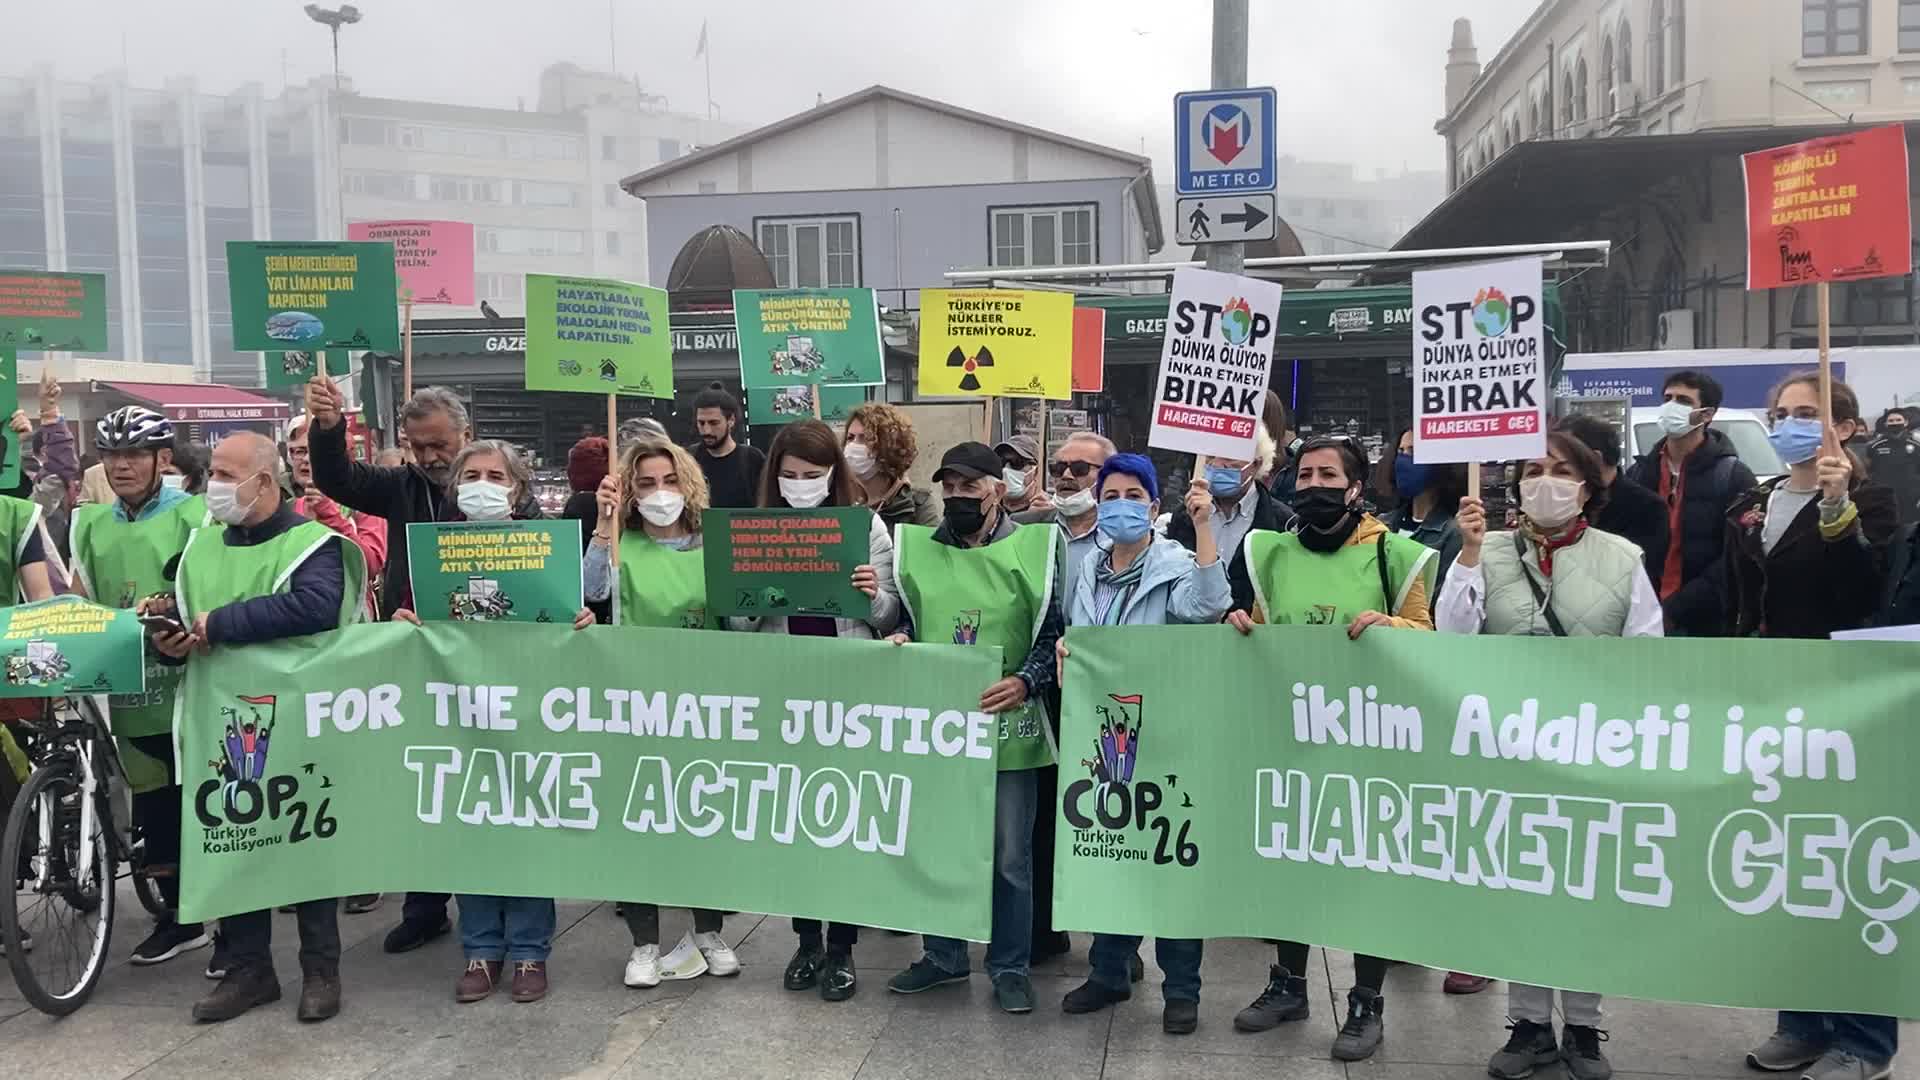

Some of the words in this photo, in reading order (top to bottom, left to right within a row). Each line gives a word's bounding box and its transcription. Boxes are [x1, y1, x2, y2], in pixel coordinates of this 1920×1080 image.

[1192, 172, 1261, 189] METRO
[1771, 202, 1851, 225] KAPATILSIN
[264, 254, 288, 276] ŞEHİR
[266, 276, 289, 291] YAT
[289, 274, 354, 291] LİMANLARI
[268, 293, 327, 308] KAPATILSIN
[557, 289, 630, 304] HAYATLARA
[631, 296, 644, 307] VE
[760, 298, 814, 310] MİNİMUM
[815, 299, 840, 308] ATIK
[948, 300, 1022, 311] TÜRKİYE'DE
[557, 302, 615, 316] EKOLOJİK
[1420, 288, 1536, 342] STOP
[557, 316, 618, 329] MALOLAN
[762, 323, 790, 333] ATIK
[793, 320, 848, 331] YÖNETİMİ
[948, 313, 1004, 323] NÜKLEER
[1174, 297, 1271, 347] STOP
[557, 330, 634, 344] KAPATILSIN.
[948, 326, 1036, 337] İSTEMİYORUZ.
[1171, 335, 1215, 362] DÜNYA
[1219, 342, 1266, 371] ÖLÜYOR
[1423, 342, 1473, 366] DÜNYA
[1478, 336, 1537, 361] ÖLÜYOR
[1168, 357, 1212, 378] İNKAR
[1216, 368, 1264, 387] ETMEYİ
[1422, 367, 1473, 383] İNKAR
[1479, 359, 1537, 379] ETMEYİ
[1163, 376, 1260, 416] BIRAK
[1422, 378, 1537, 414] BIRAK
[1163, 409, 1225, 430] HAREKETE
[1230, 419, 1252, 437] GEÇ
[1426, 418, 1499, 434] HAREKETE
[1507, 415, 1535, 432] GEÇ
[730, 519, 776, 529] MADEN
[778, 518, 841, 533] ÇIKARMA
[438, 532, 504, 545] MİNİMUM
[506, 532, 538, 543] ATIK
[541, 532, 552, 543] &
[731, 534, 758, 544] HEM
[760, 532, 797, 544] DOĞA
[438, 543, 552, 559] SÜRDÜRÜLEBİLİR
[732, 547, 762, 557] HEM
[767, 547, 784, 557] DE
[440, 561, 472, 573] ATIK
[475, 556, 545, 571] YÖNETİMİ
[304, 684, 404, 738] FOR
[426, 681, 518, 732] THE
[540, 686, 761, 741] CLIMATE
[781, 700, 994, 760] JUSTICE
[1291, 682, 1423, 754] iklim
[1449, 693, 1690, 772] Adaleti
[1722, 706, 1857, 803] için
[404, 745, 600, 830] TAKE
[623, 755, 912, 857] ACTION
[202, 824, 258, 841] Türkiye
[1072, 829, 1126, 846] Türkiye
[202, 833, 283, 855] Koalisyonu
[1072, 843, 1148, 862] Koalisyonu
[1254, 767, 1676, 908] HAREKETE
[1707, 808, 1920, 956] GEÇ
